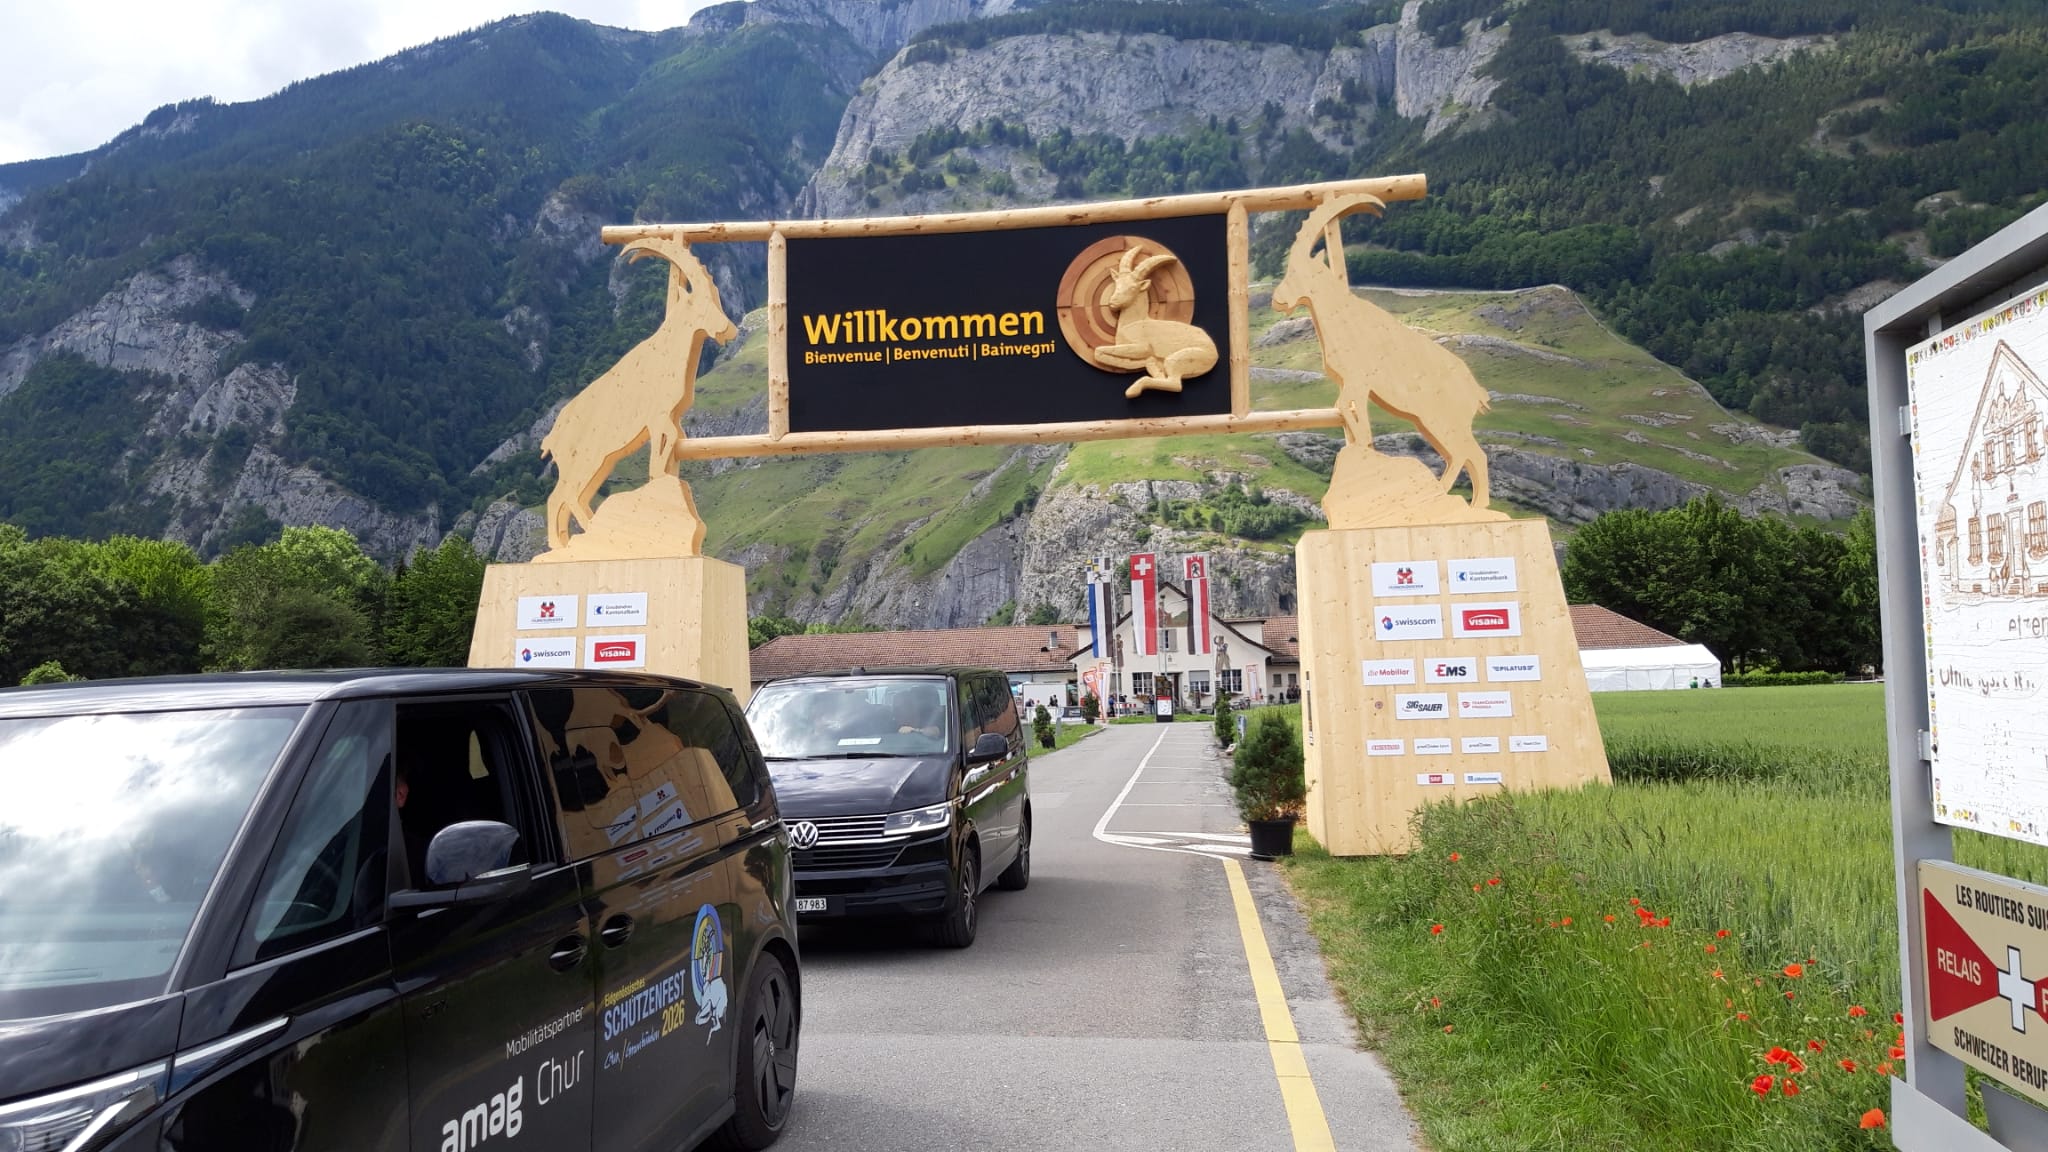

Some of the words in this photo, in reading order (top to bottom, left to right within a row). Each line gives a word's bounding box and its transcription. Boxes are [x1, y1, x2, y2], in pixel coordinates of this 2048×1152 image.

[803, 309, 1045, 345] Willkommen
[804, 349, 883, 365] Bienvenue
[893, 344, 970, 361] Benvenuti
[981, 340, 1056, 361] Bainvegni
[1395, 617, 1436, 626] swisscom
[533, 650, 571, 658] swisscom
[1379, 668, 1409, 677] Mobiliar
[1435, 664, 1467, 677] EMS
[1406, 700, 1420, 709] SIG
[1418, 703, 1443, 712] SAUER
[1956, 884, 1973, 908] LES
[1974, 889, 2025, 924] ROUTIERS
[1937, 947, 1982, 986] RELAIS
[604, 968, 686, 1041] SCHÜTZENFEST
[661, 999, 686, 1038] 2026
[506, 1006, 584, 1060] Mobilitätspartner
[1954, 1026, 2010, 1073] SCHWEIZER
[2011, 1054, 2048, 1092] BERUF
[441, 1075, 523, 1152] amag
[537, 1050, 584, 1105] Chur
